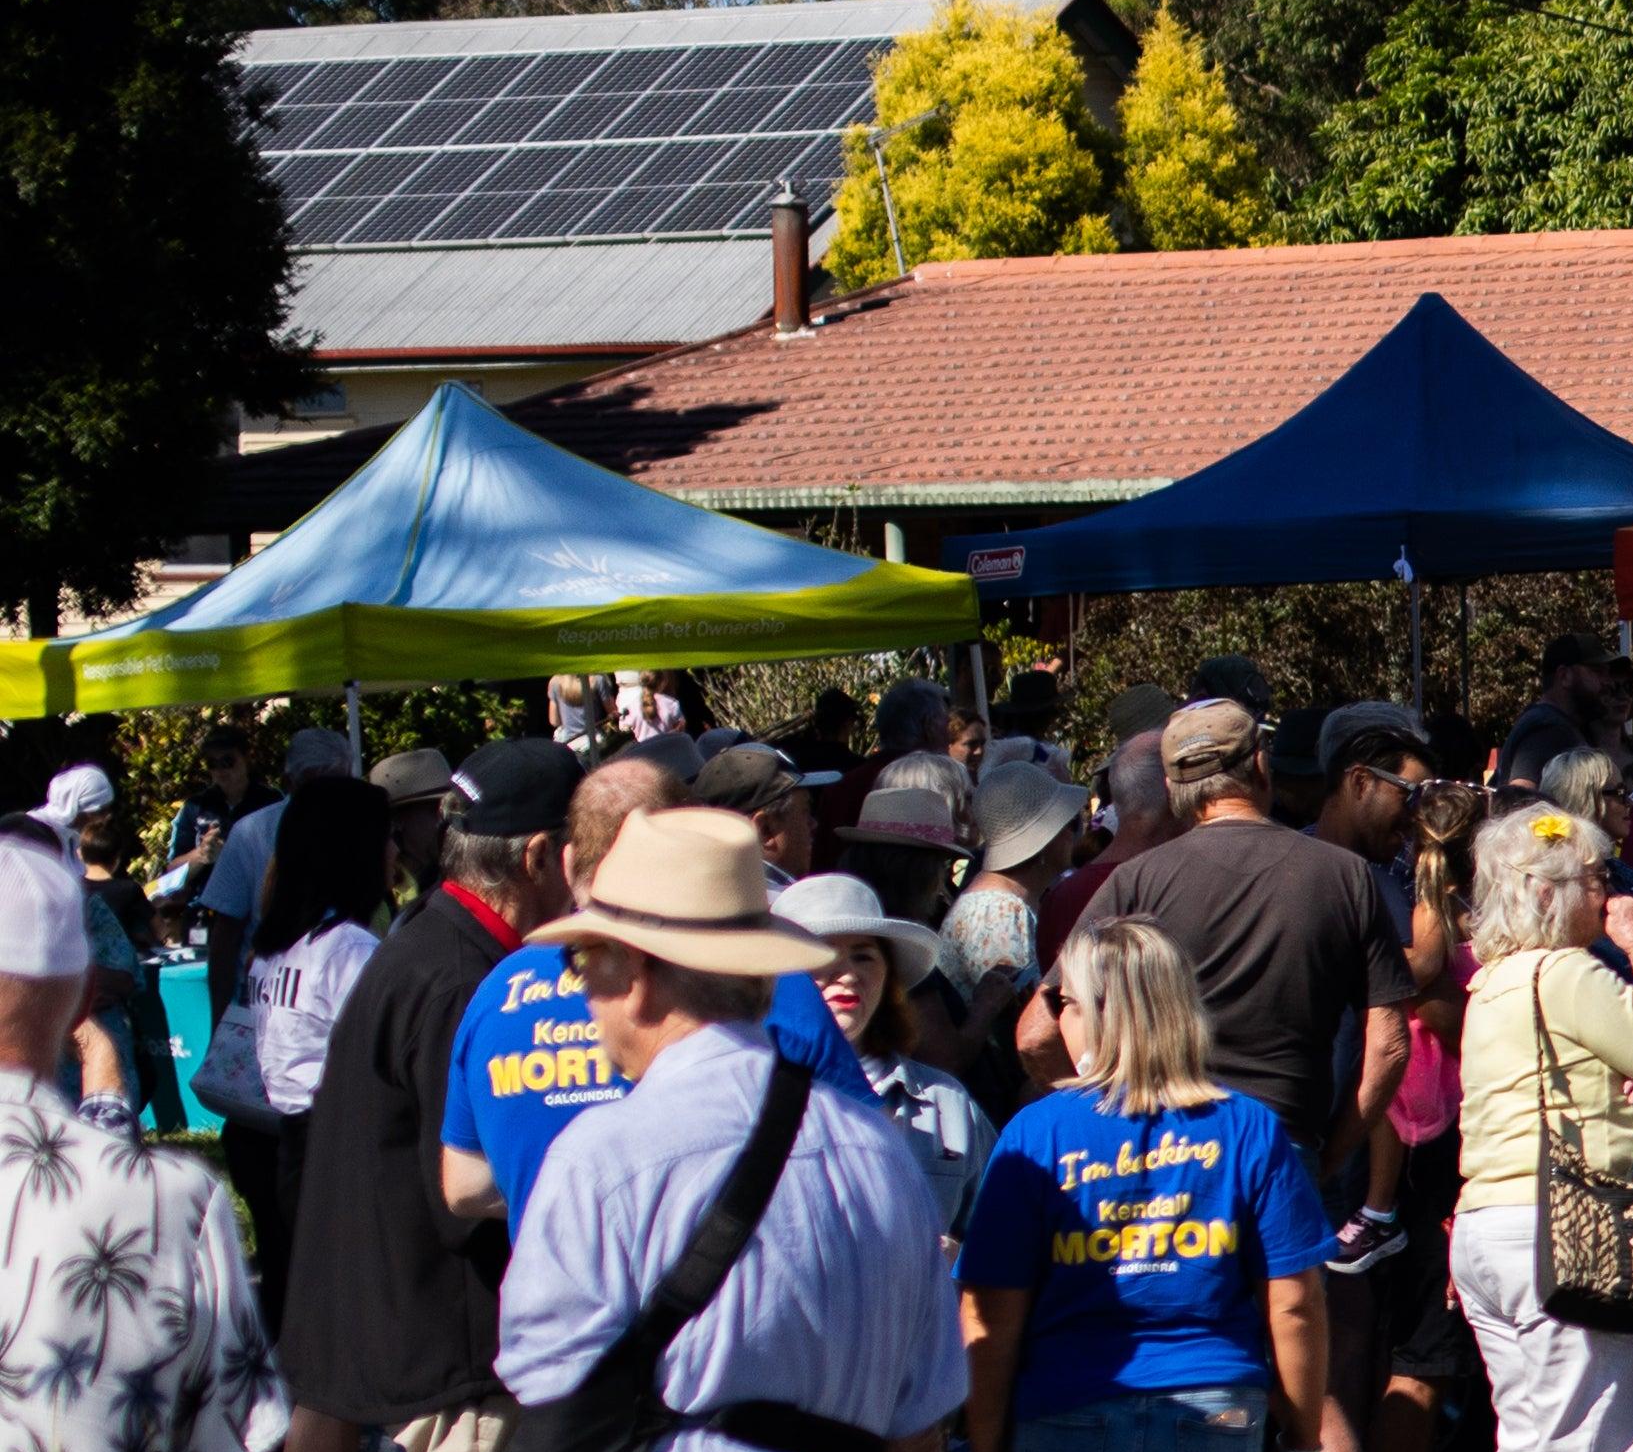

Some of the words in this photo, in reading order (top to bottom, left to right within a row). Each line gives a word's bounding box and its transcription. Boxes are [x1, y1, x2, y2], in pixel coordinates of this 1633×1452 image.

[970, 555, 1012, 574] Coleman
[556, 624, 659, 647] Responsible
[662, 621, 692, 639] Pet
[696, 617, 786, 638] Ownership
[145, 654, 163, 673] Pet
[500, 969, 554, 1013] I'm
[544, 1086, 624, 1107] CALOUNDRA
[1058, 1149, 1113, 1192] I'm
[1116, 1130, 1222, 1177] backing
[1098, 1192, 1192, 1223] Kendall
[1051, 1218, 1239, 1265] MORTON
